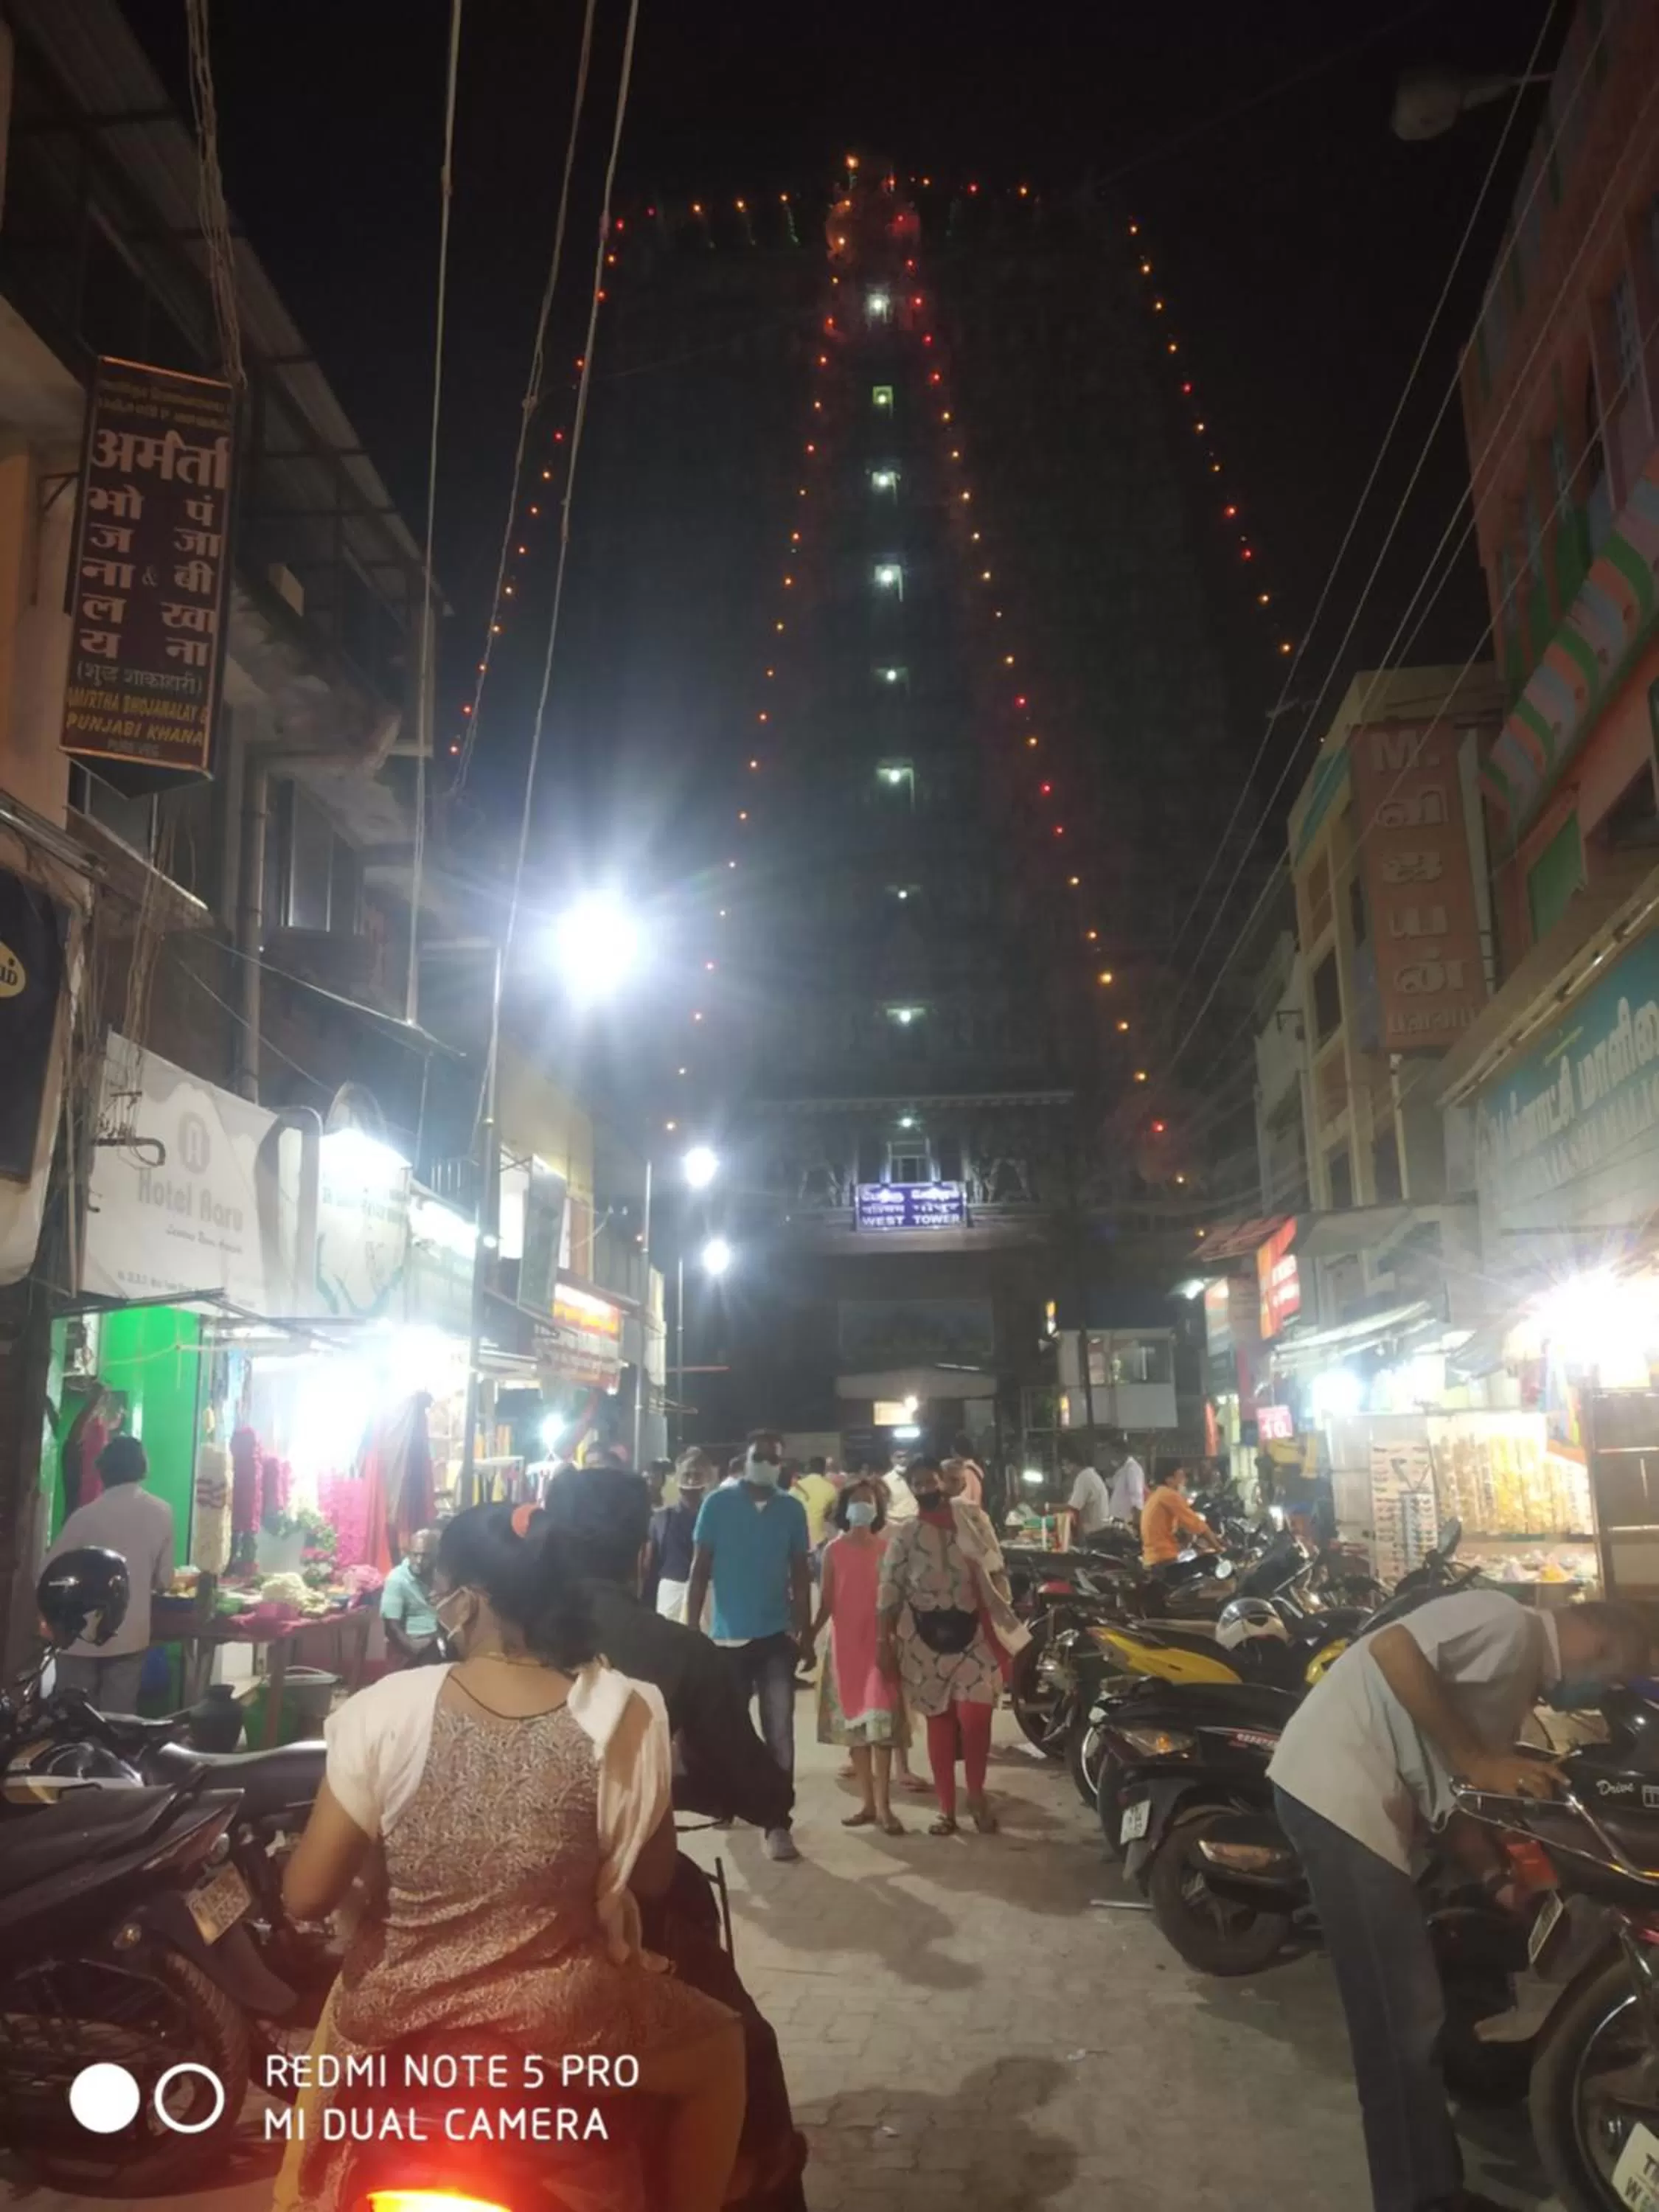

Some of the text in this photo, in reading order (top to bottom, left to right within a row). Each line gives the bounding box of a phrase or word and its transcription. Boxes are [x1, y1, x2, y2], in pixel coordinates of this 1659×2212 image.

[66, 712, 204, 747] PUNJABI KHANA
[862, 1214, 961, 1225] WEST TOWER
